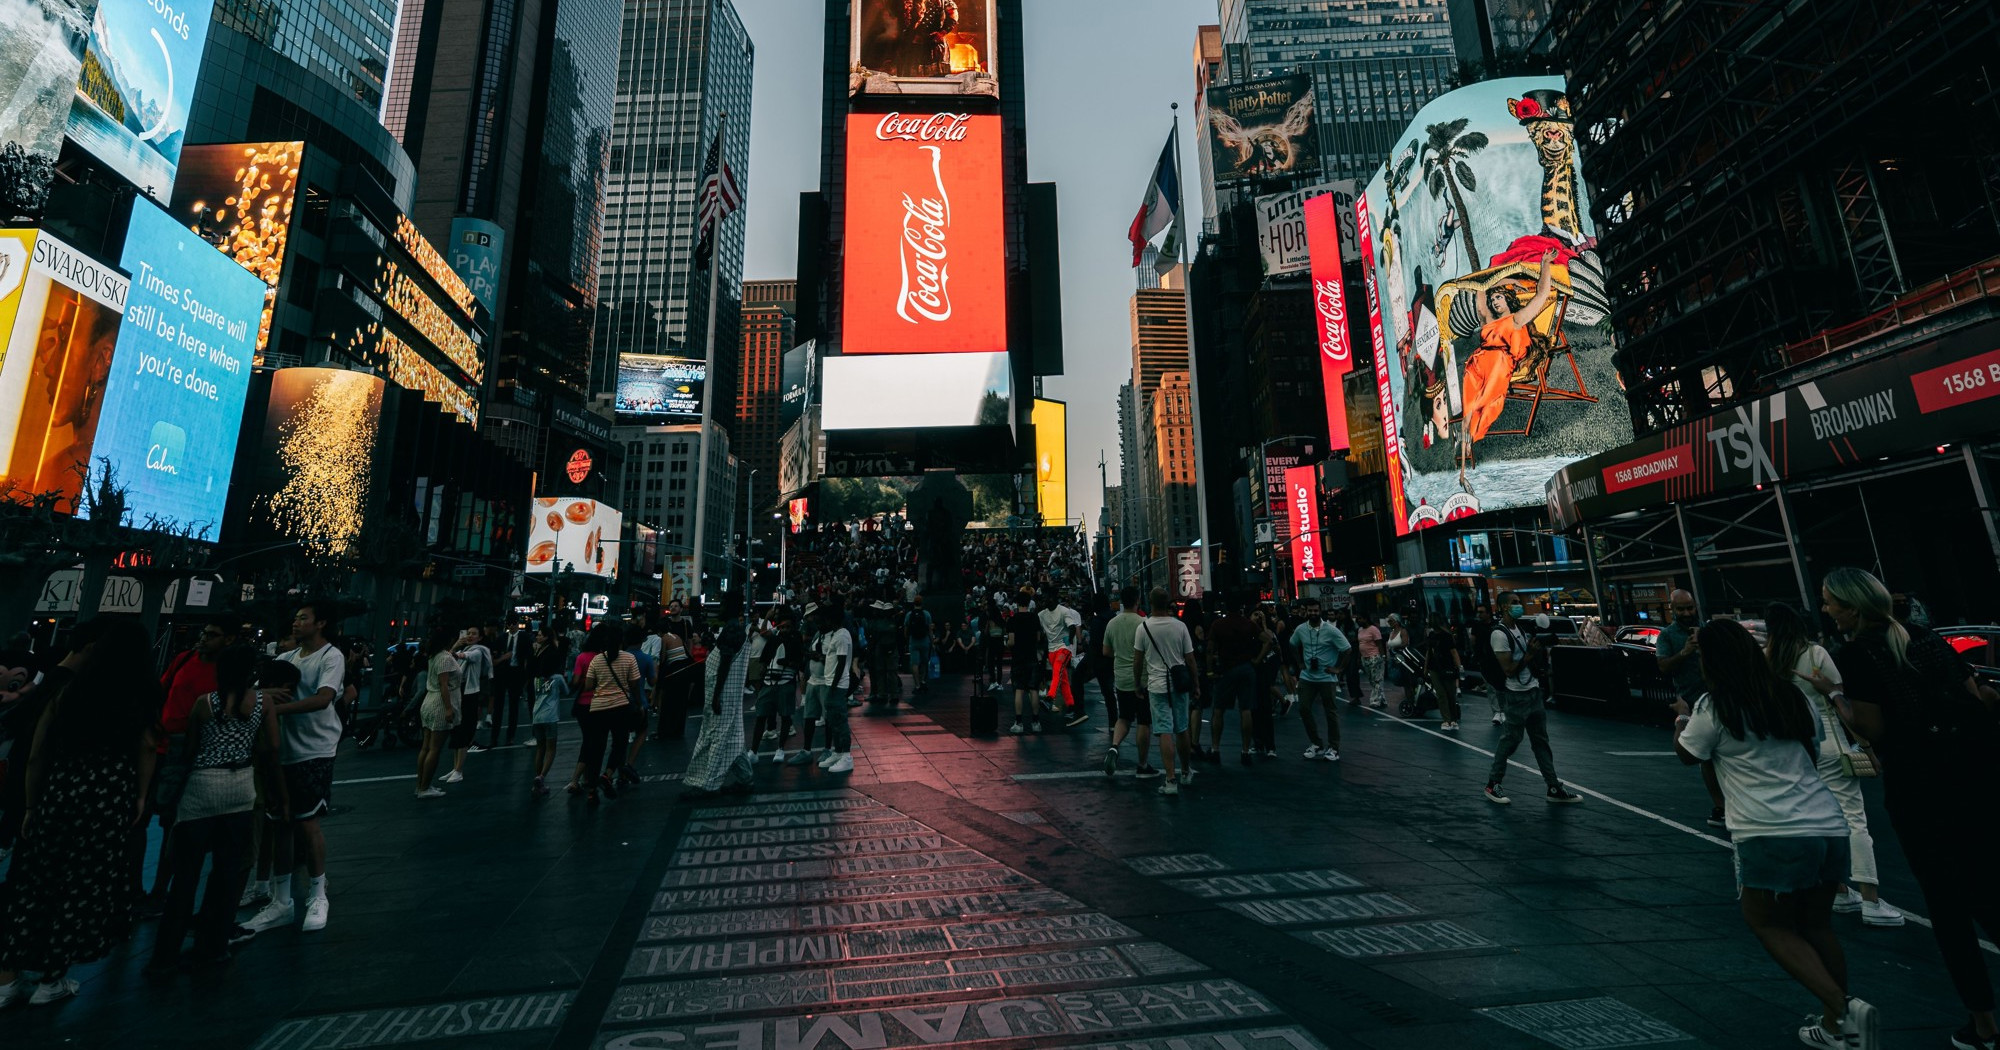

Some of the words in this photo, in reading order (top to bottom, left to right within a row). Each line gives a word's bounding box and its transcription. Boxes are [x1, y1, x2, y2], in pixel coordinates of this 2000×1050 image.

[1228, 96, 1260, 114] Harry
[1258, 90, 1292, 109] Potter
[1229, 86, 1243, 94] ON
[1244, 80, 1287, 92] BROADWAY
[875, 111, 970, 142] Coca-Cola
[1317, 190, 1354, 209] OP
[466, 232, 498, 248] npr
[901, 192, 951, 322] Coca-Cola
[33, 239, 128, 307] SWAROVSKI
[139, 261, 180, 305] Times
[182, 288, 226, 331] Square
[227, 320, 248, 343] will
[1315, 278, 1349, 362] Coca-Cola
[127, 304, 156, 330] still
[156, 312, 177, 342] be
[177, 324, 208, 358] here
[209, 345, 241, 375] when
[1373, 323, 1388, 380] COME
[136, 352, 182, 385] you're
[185, 367, 220, 401] done.
[662, 362, 706, 371] SPECTACULAR
[1943, 368, 1986, 394] 1568
[1380, 382, 1398, 454] INSIDE!
[1809, 388, 1897, 441] BROADWAY
[1706, 399, 1780, 485] TSX
[146, 443, 178, 475] Calm
[1265, 456, 1300, 466] EVERY
[1614, 468, 1633, 483] 1568
[1634, 456, 1680, 479] BROADWAY
[1177, 550, 1200, 597] tkts
[683, 811, 867, 832] SIMON
[758, 799, 872, 816] BROADWAY
[677, 834, 944, 867] AMBASSADOR
[683, 826, 831, 850] GERSHWIN
[661, 883, 797, 905] FRIEDMAN
[1177, 868, 1368, 898] PALACE
[649, 907, 792, 928] ATKINSON
[801, 892, 1009, 928] FONTANNE
[1238, 892, 1424, 924] LYCEUM
[646, 918, 792, 940] BROOKS
[1309, 920, 1492, 958] BELASCO
[640, 933, 841, 974] IMPERIAL
[953, 950, 1112, 973] BOOTH
[1001, 964, 1126, 987] SHUBERT
[615, 987, 827, 1020] MAJESTIC
[1056, 981, 1248, 1011] HAYES
[251, 992, 569, 1050] HIRSCHFELD
[1065, 996, 1273, 1031] HELEN
[1543, 1020, 1685, 1048] STEPHEN
